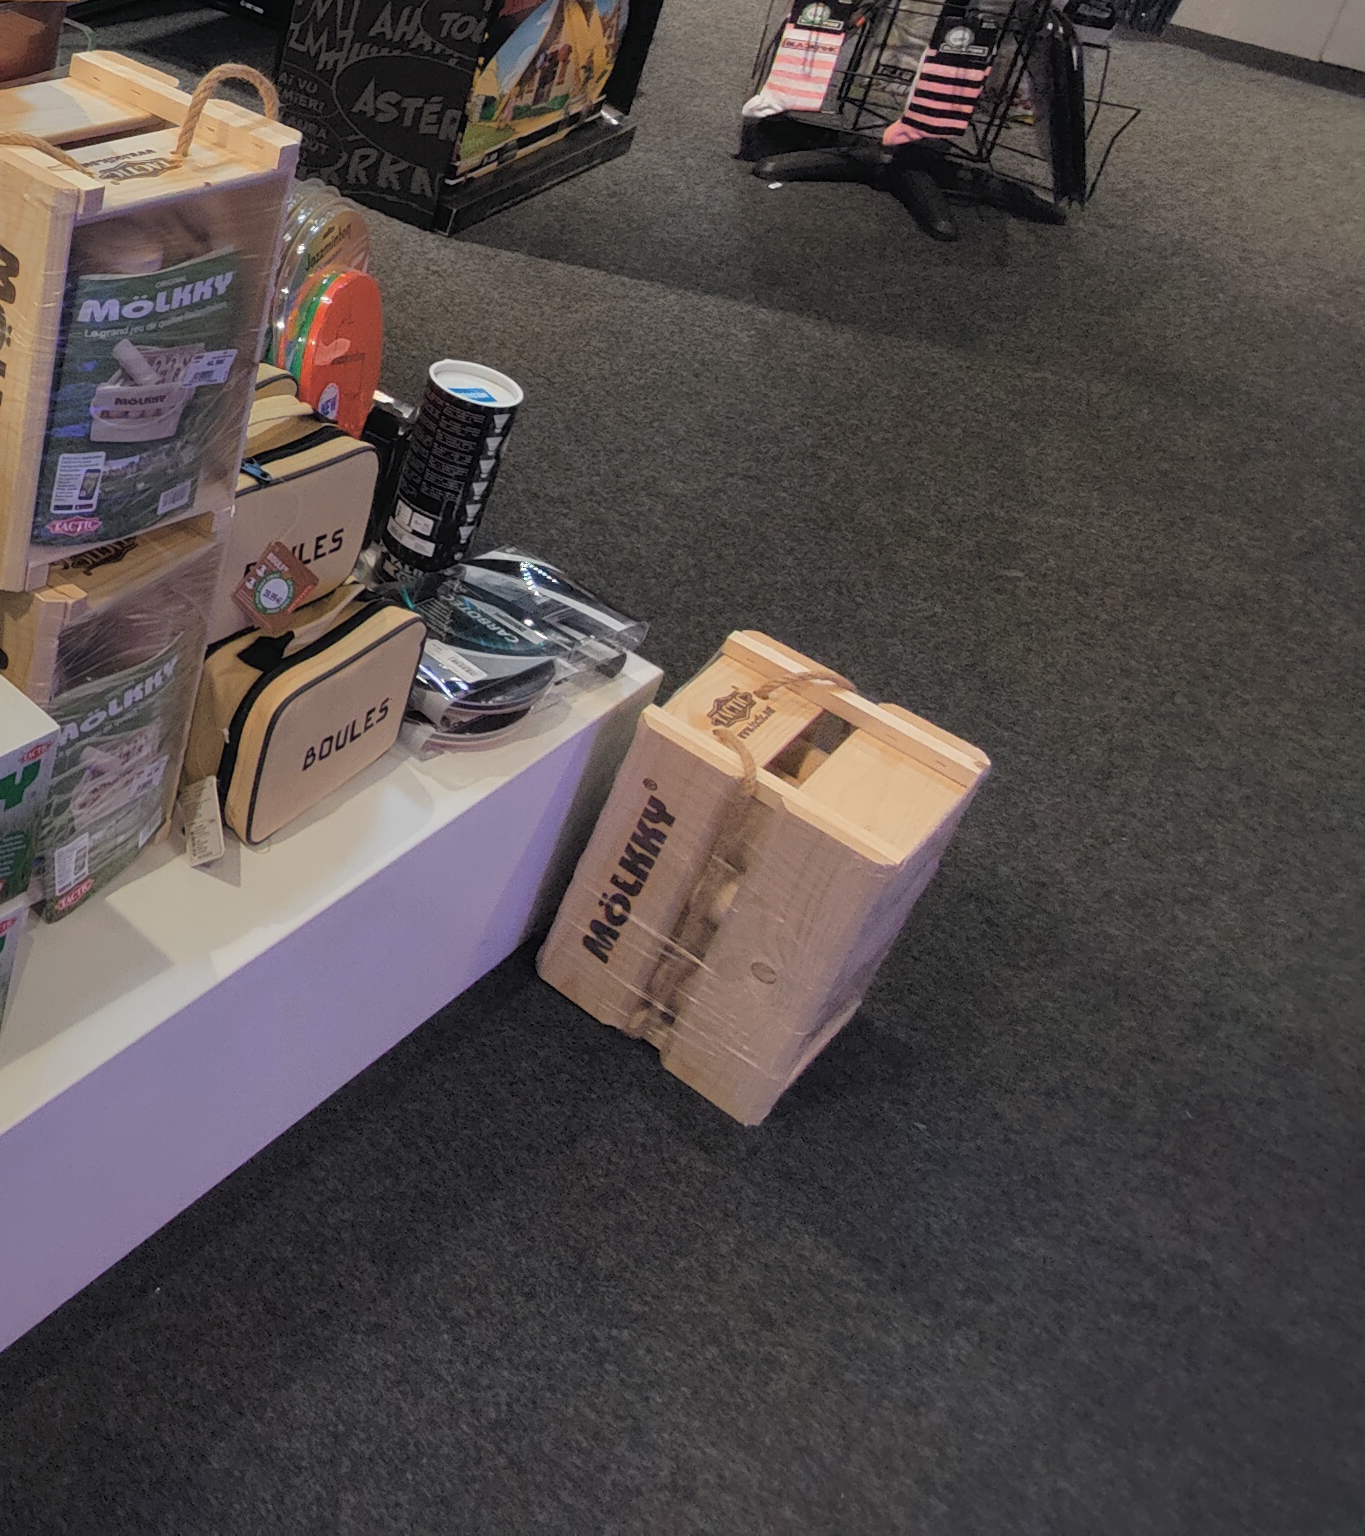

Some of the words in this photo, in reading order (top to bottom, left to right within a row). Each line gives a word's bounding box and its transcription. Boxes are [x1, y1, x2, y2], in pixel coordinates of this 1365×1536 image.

[305, 222, 352, 271] Jazzminton
[76, 271, 235, 323] MÖLKKY
[114, 394, 167, 407] MÖLKKY
[48, 519, 101, 534] TACTIC
[302, 697, 394, 772] BOULES
[583, 794, 677, 965] MÖLKKY
